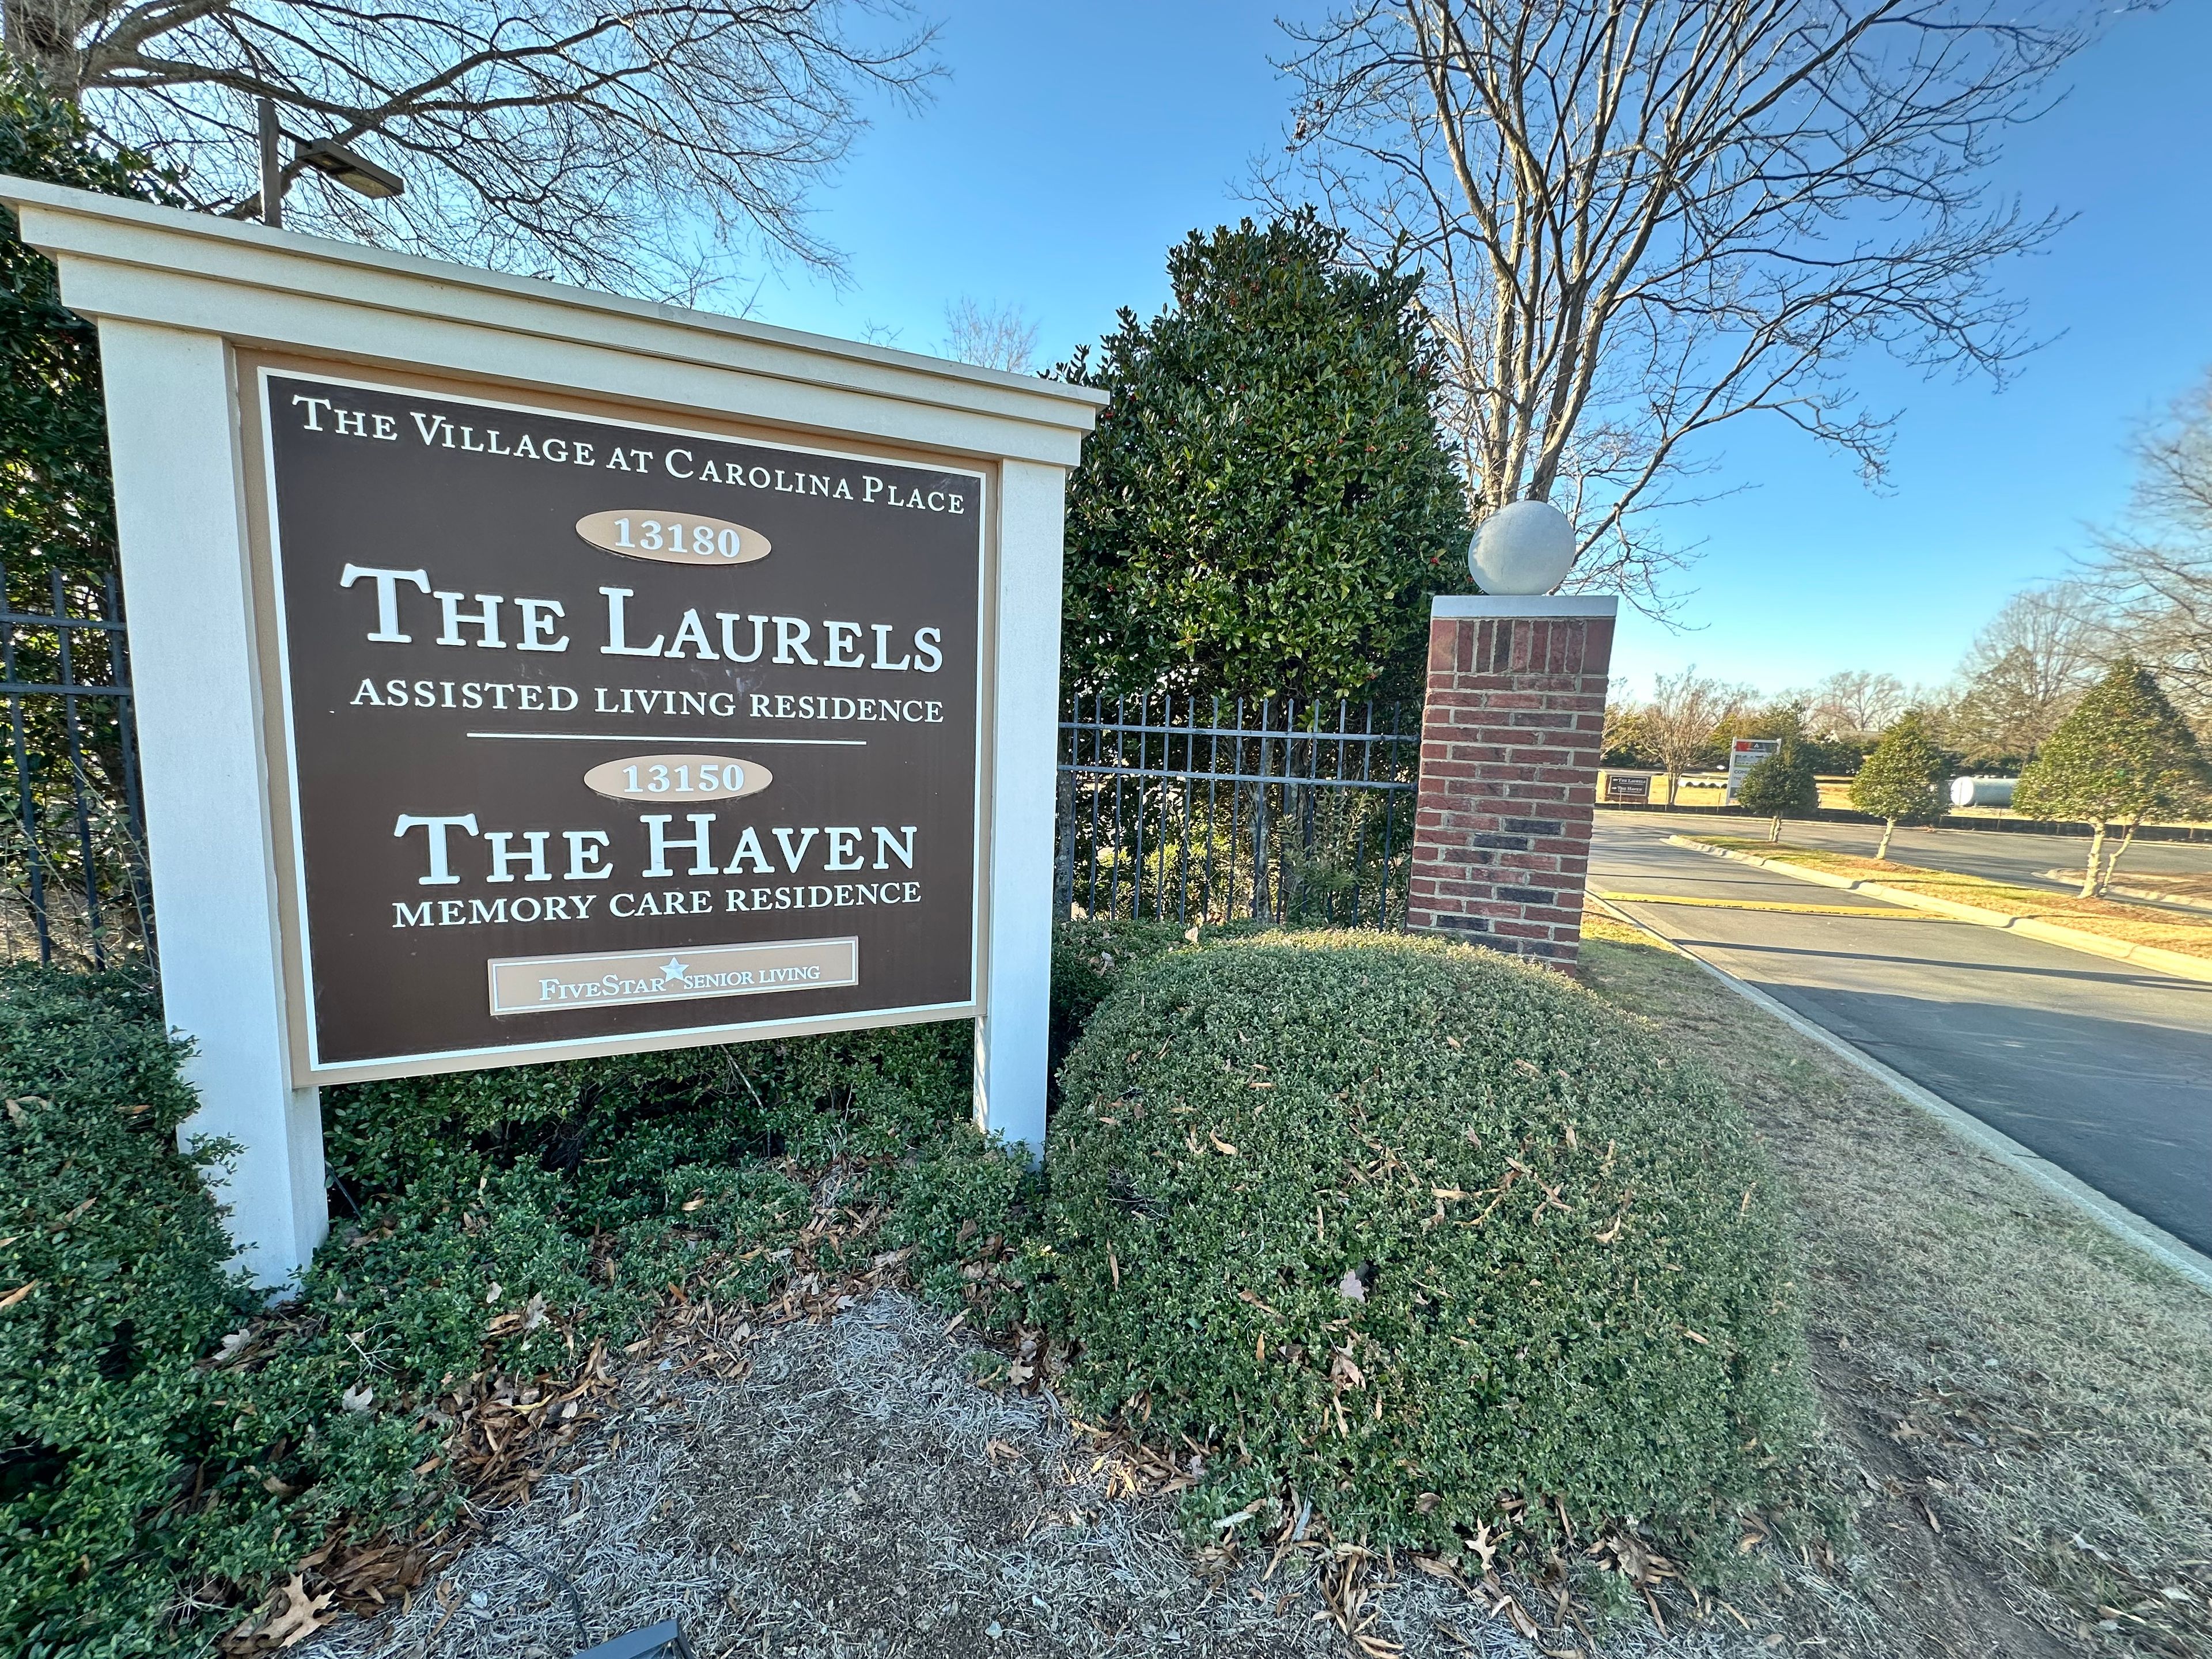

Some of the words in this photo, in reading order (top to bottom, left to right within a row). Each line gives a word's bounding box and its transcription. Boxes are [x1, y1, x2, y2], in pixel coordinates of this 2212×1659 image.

[291, 394, 398, 441] THE
[409, 411, 596, 467] VILLAGE
[605, 447, 654, 474] AT
[665, 449, 854, 501] CAROLINA
[862, 475, 964, 514] PLACE
[613, 517, 740, 558] 13180
[339, 562, 570, 652] THE
[599, 586, 943, 673] LAURELS
[349, 677, 579, 711] ASSISTED
[594, 687, 736, 717] LIVING
[749, 694, 944, 723] RESIDENCE
[622, 763, 744, 793] 13150
[393, 813, 613, 885] THE
[639, 813, 918, 878] HAVEN
[392, 895, 597, 928] MEMORY
[609, 890, 713, 918] CARE
[725, 881, 922, 912] RESIDENCE
[683, 970, 755, 990] SENIOR
[757, 965, 821, 984] LIVING
